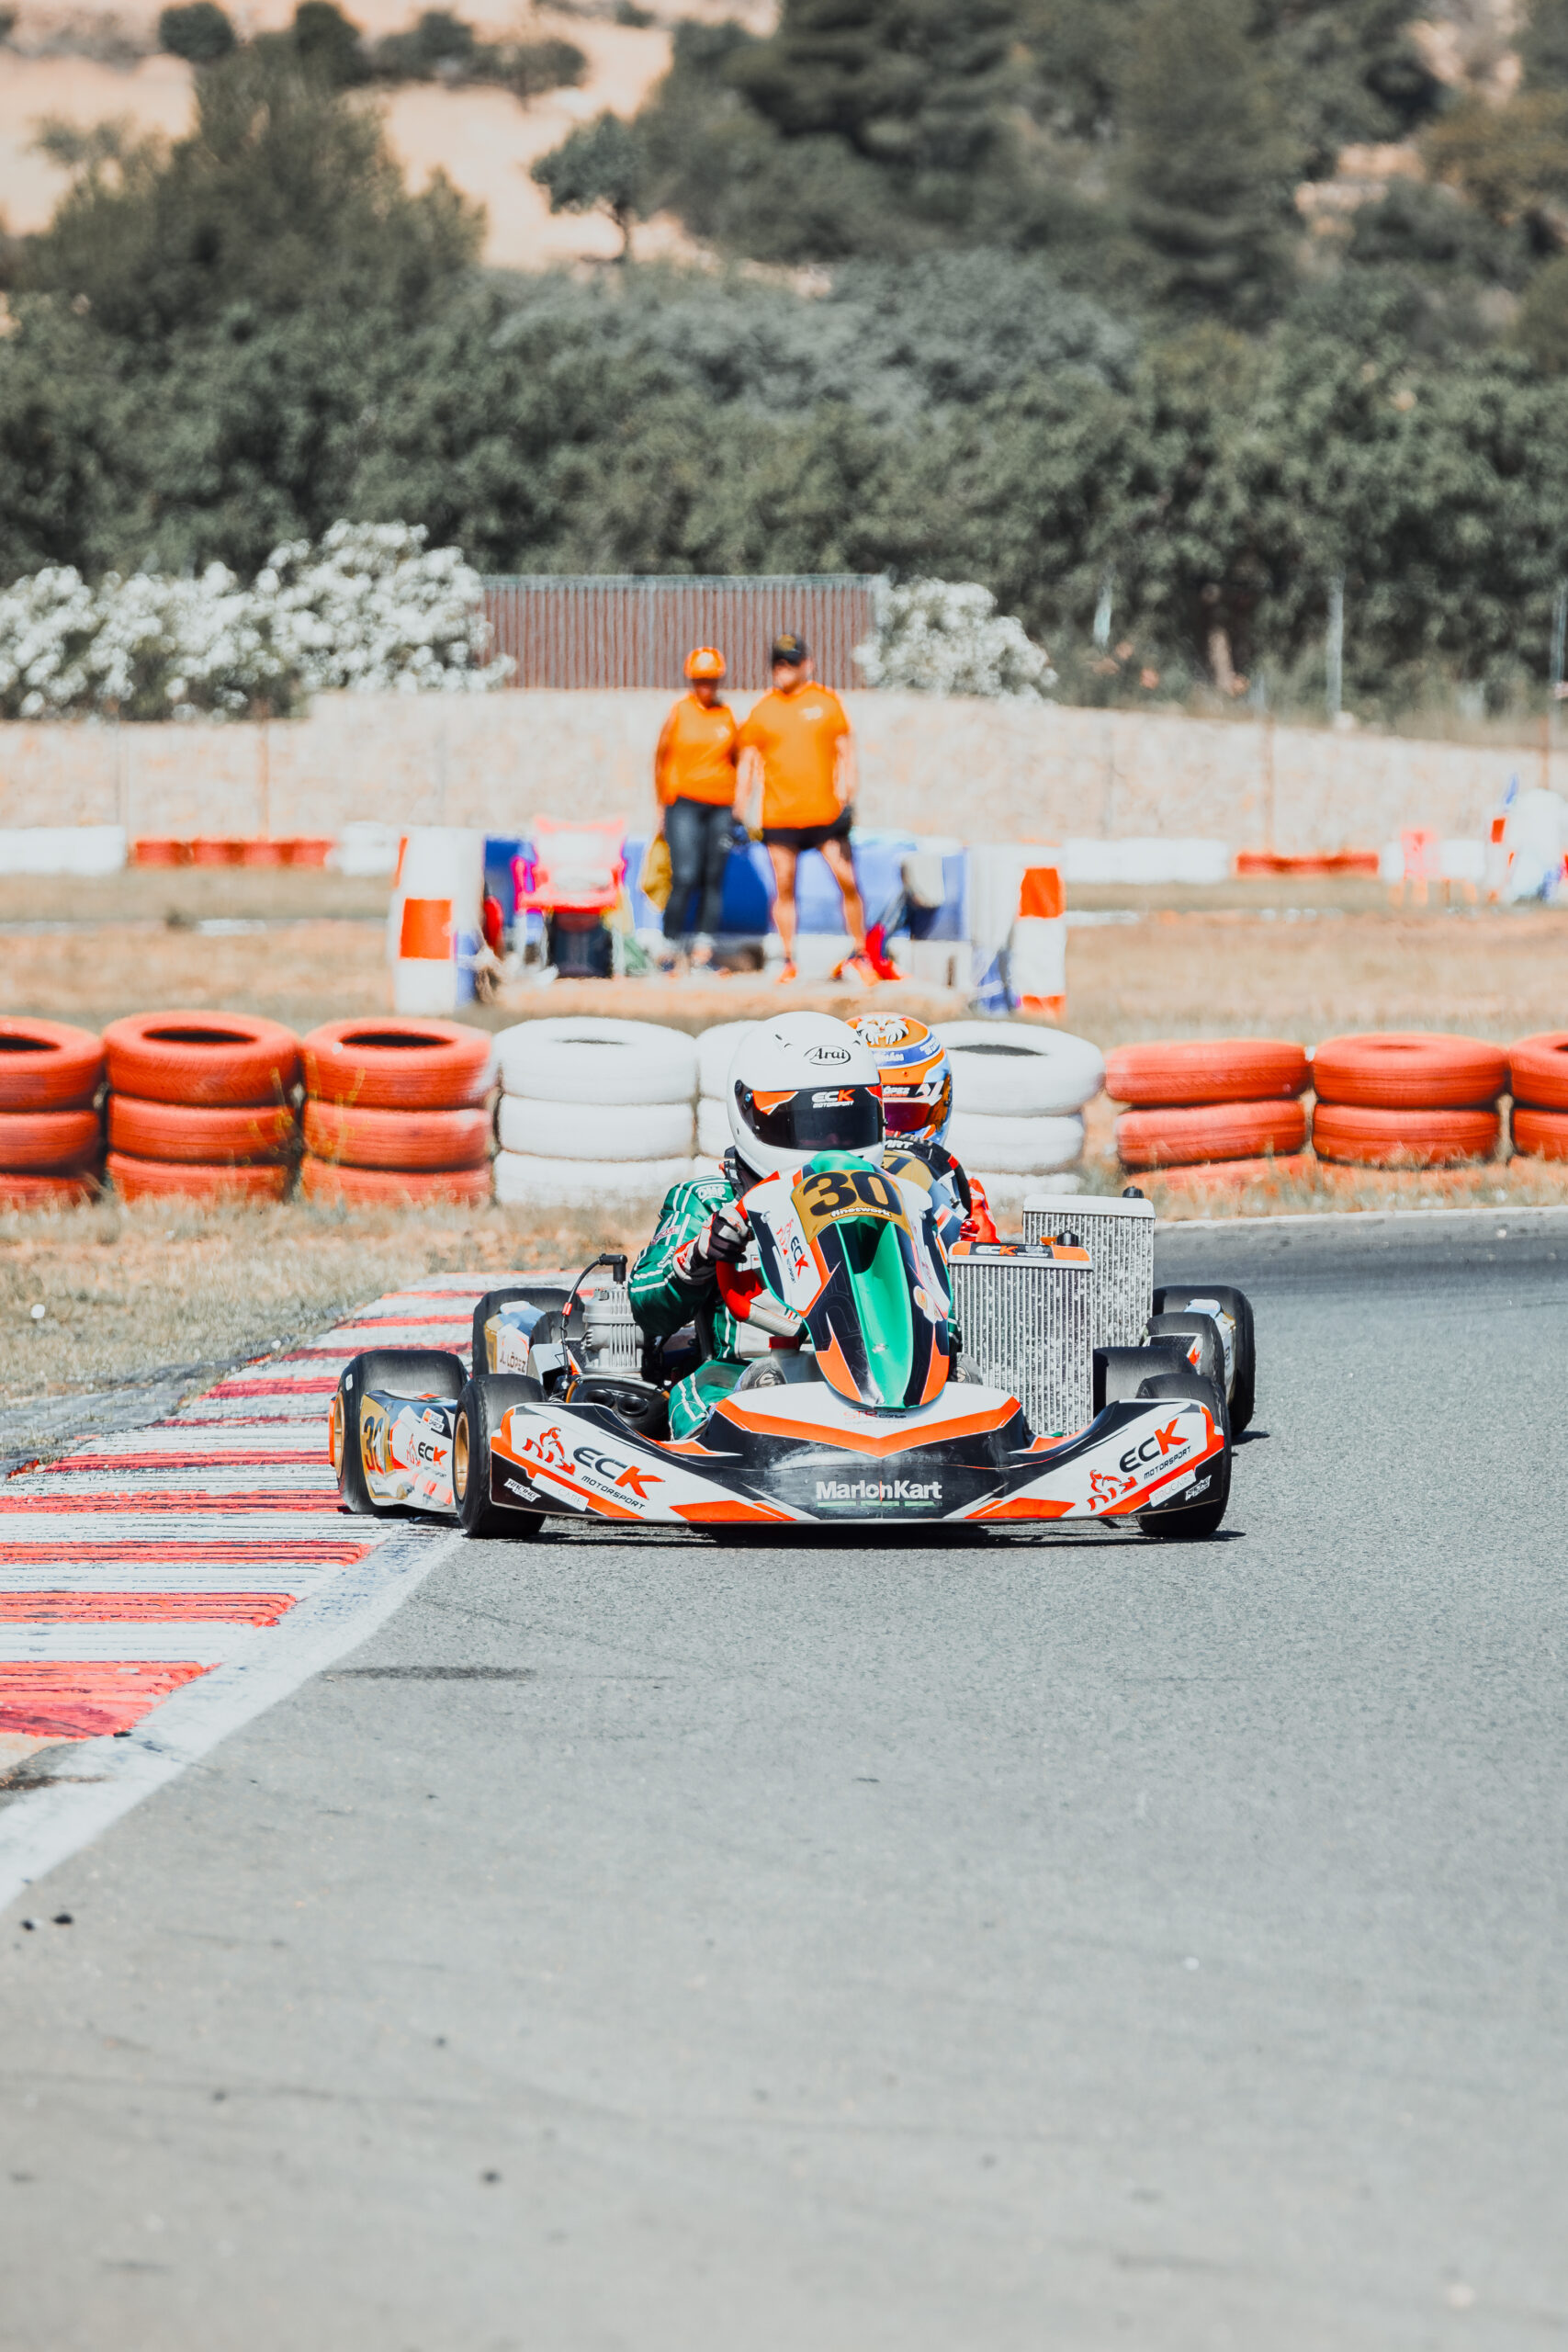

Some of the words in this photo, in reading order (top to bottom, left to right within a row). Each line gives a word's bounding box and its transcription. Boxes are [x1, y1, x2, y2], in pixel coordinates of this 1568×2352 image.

[812, 1047, 846, 1061] Arai
[811, 1089, 855, 1102] ECK
[697, 1186, 726, 1200] OMP
[803, 1171, 902, 1216] 30
[791, 1235, 809, 1279] ECK
[418, 1442, 447, 1469] ECK
[1120, 1418, 1189, 1473] ECK
[573, 1447, 665, 1500] ECK
[1144, 1446, 1190, 1480] MOTORSPORT
[581, 1476, 646, 1510] MOTORSPORT
[816, 1480, 942, 1499] MarlonKart
